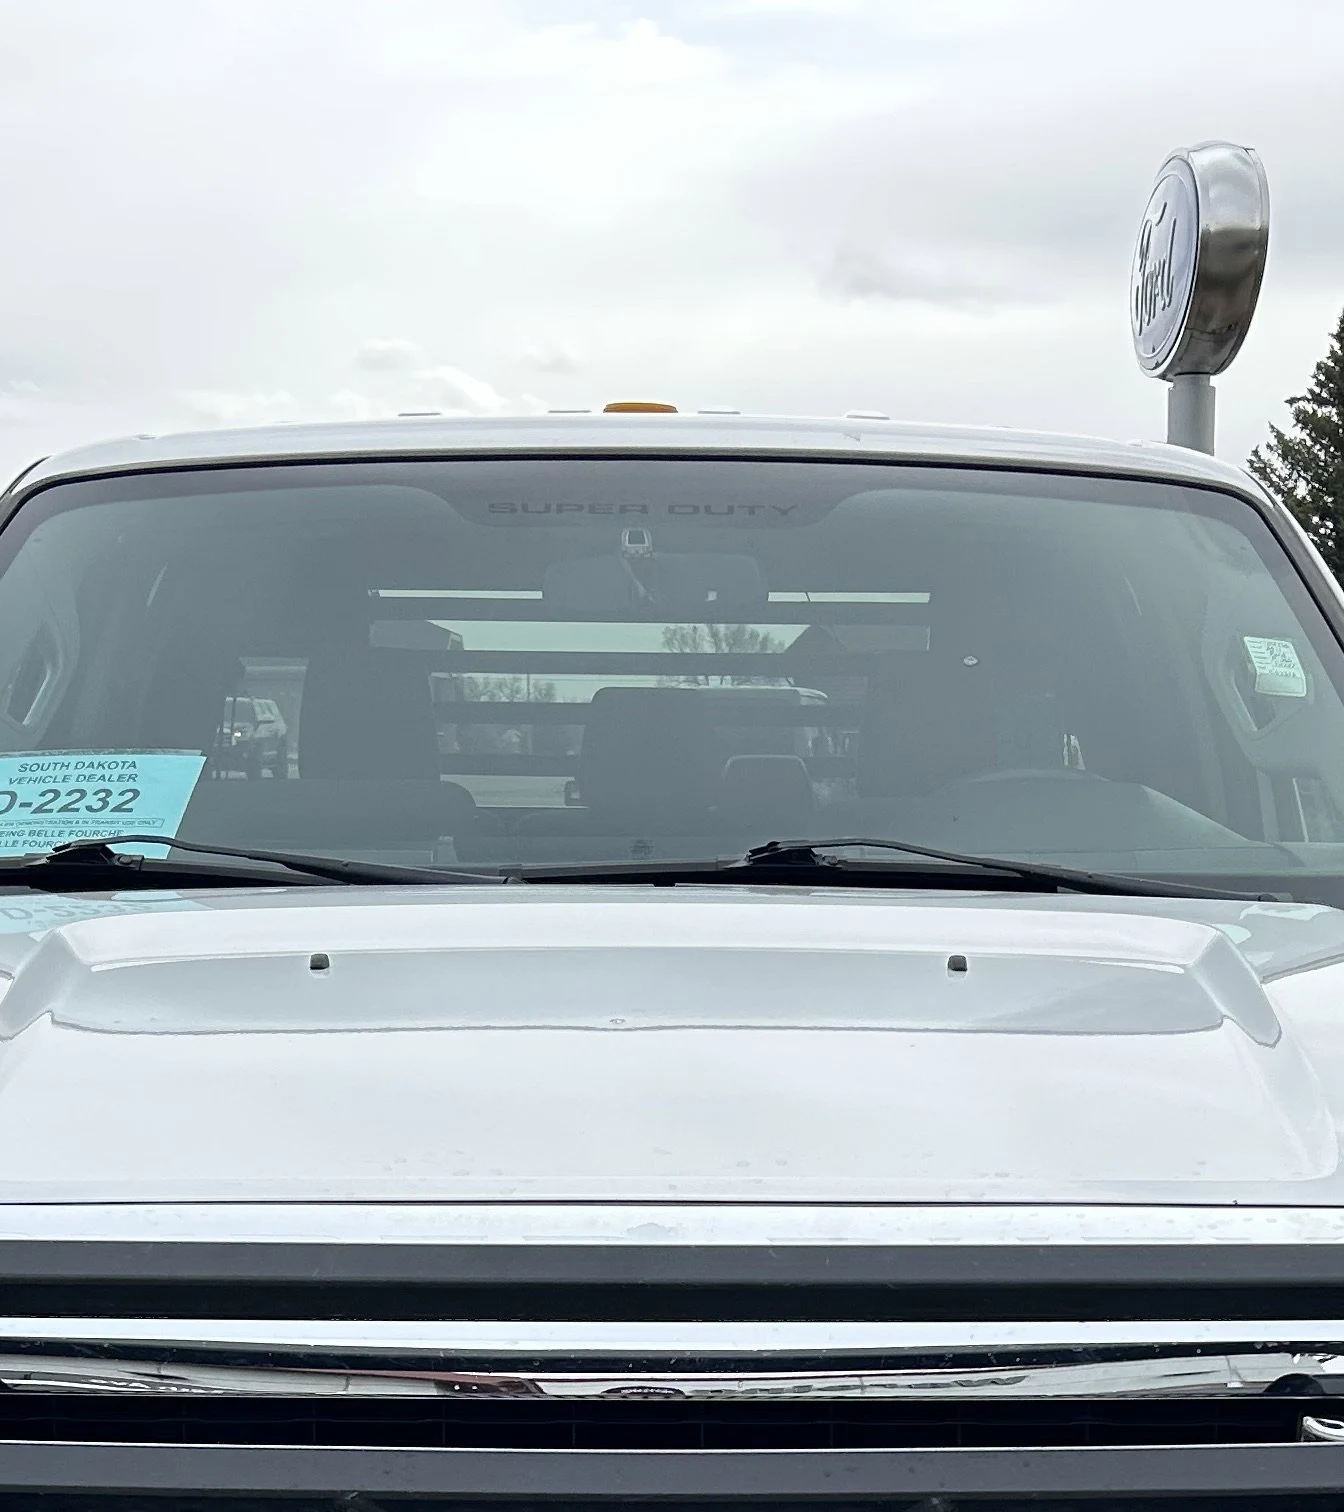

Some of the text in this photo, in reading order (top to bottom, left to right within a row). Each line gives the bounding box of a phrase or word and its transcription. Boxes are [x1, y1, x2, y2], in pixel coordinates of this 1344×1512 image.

[1134, 201, 1177, 336] Ford
[487, 501, 798, 517] SUPER DUTY
[17, 760, 138, 773] SOUTH DAKOTA
[8, 773, 139, 785] VEHICLE DEALER
[28, 829, 65, 838] BELLE
[21, 840, 67, 849] FOURC
